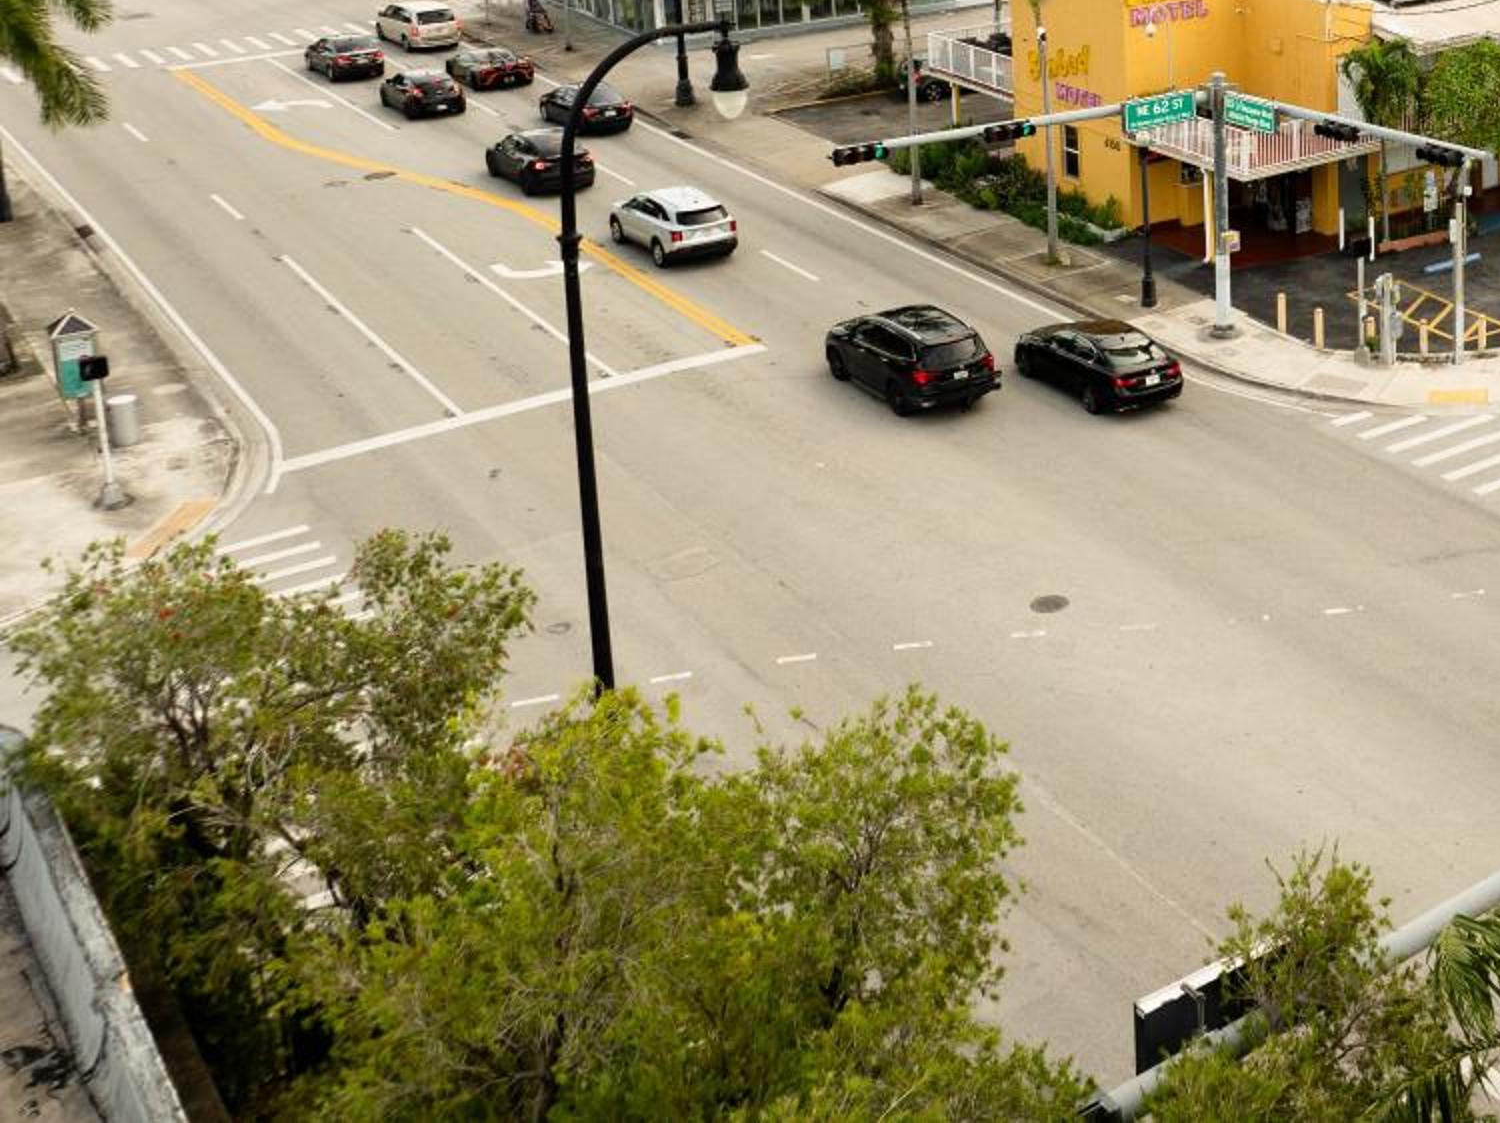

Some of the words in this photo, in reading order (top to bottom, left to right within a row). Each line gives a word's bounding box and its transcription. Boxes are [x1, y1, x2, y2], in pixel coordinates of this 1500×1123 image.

[1027, 45, 1090, 82] Snbad
[1136, 105, 1150, 116] NE
[1153, 100, 1170, 114] 62
[1172, 98, 1185, 110] ST
